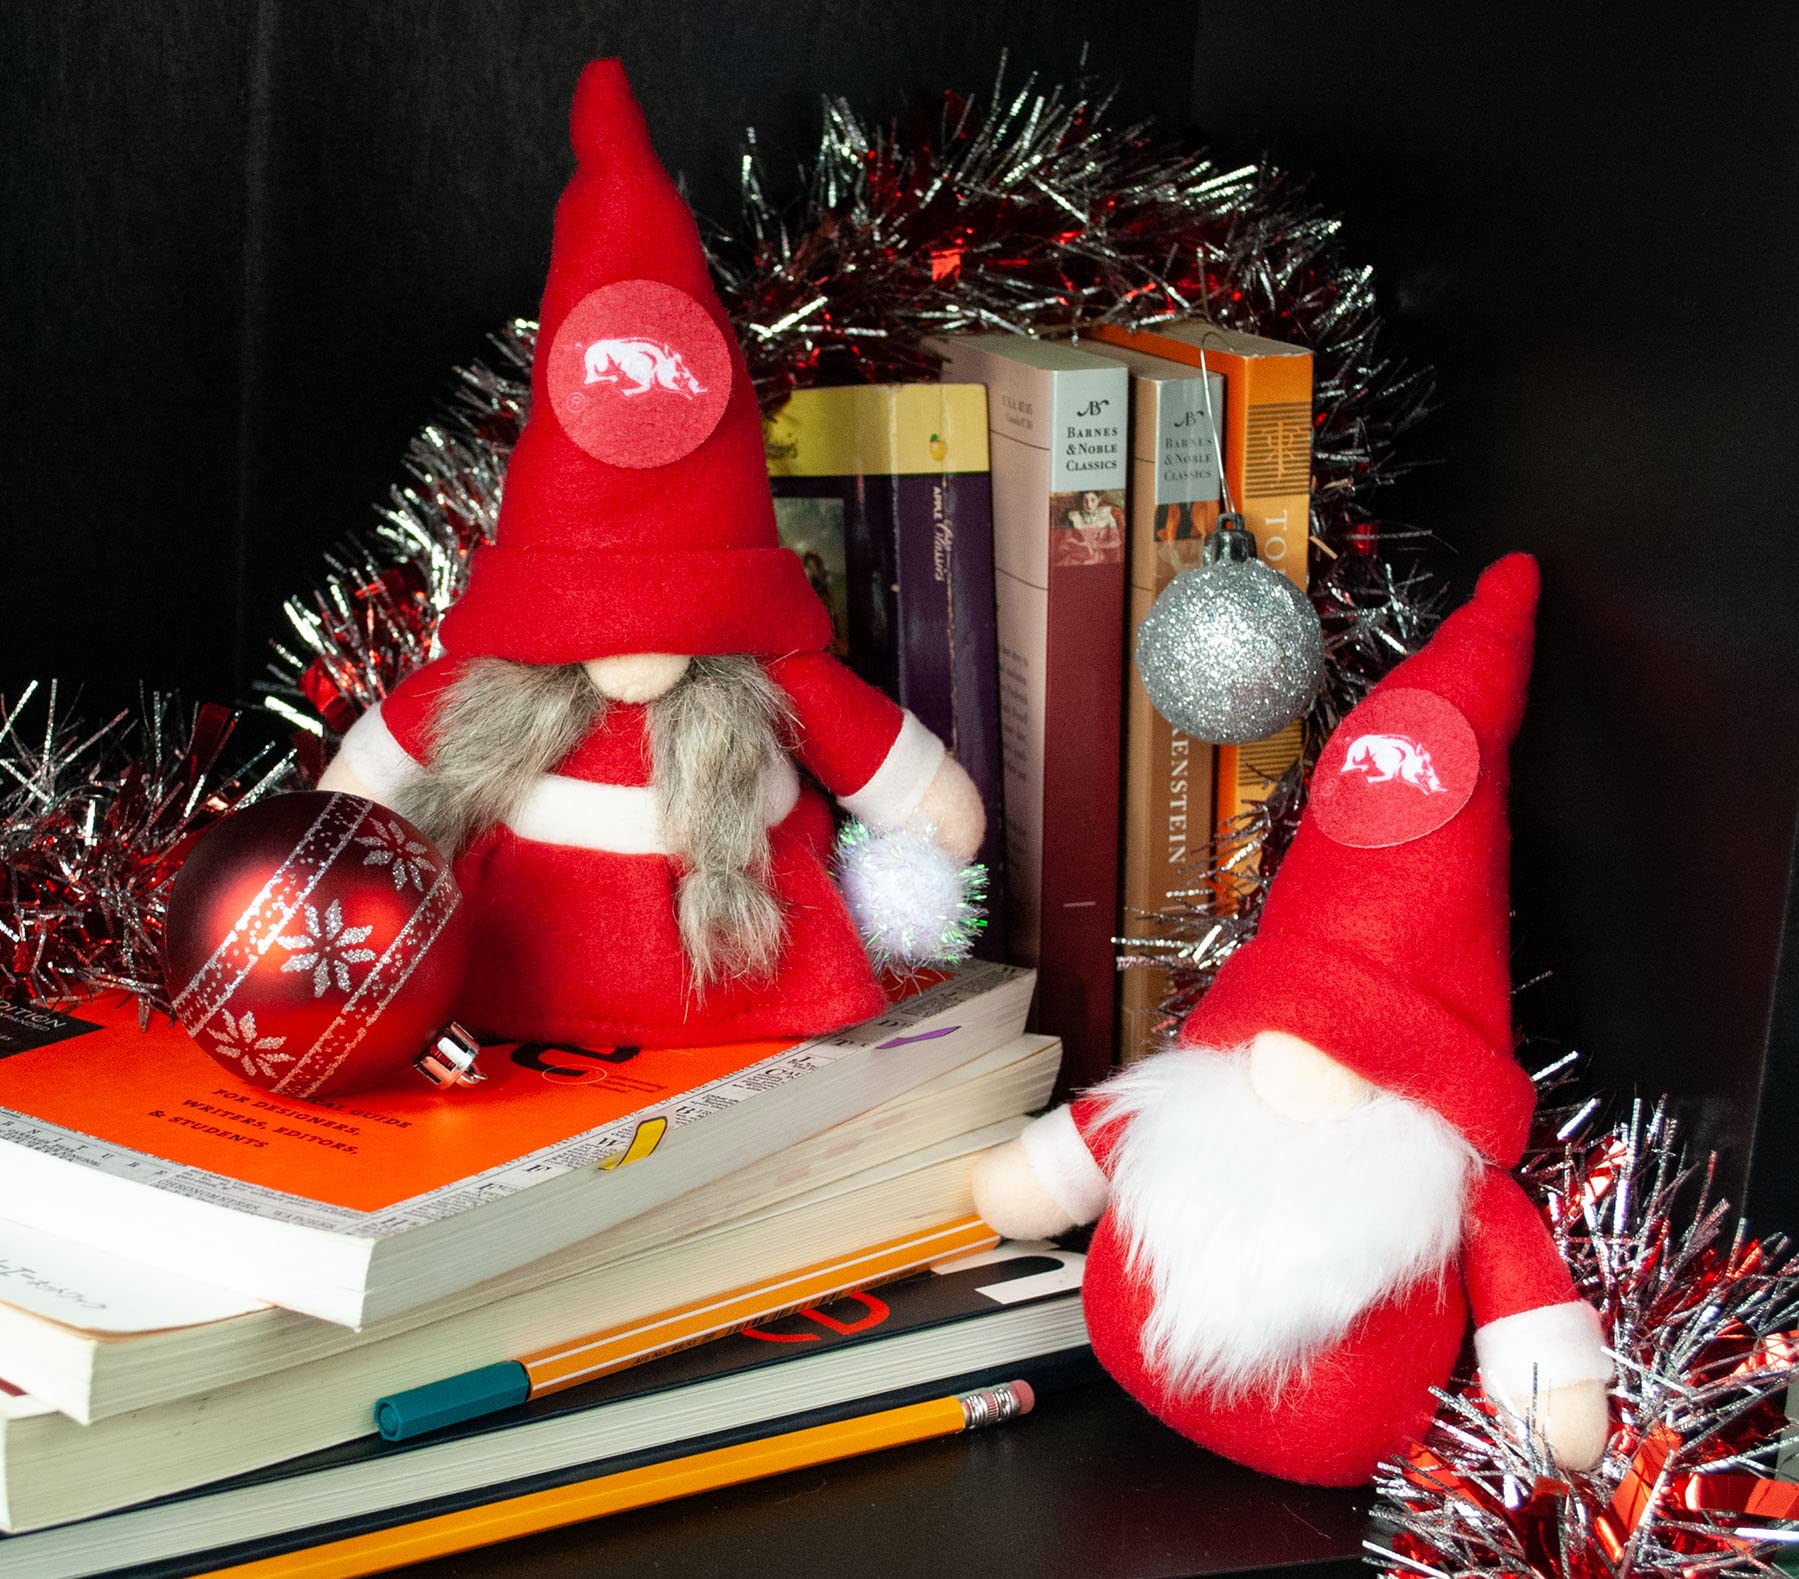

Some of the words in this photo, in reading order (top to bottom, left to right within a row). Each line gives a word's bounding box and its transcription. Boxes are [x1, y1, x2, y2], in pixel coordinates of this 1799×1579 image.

[1067, 426, 1118, 438] BARNES
[1165, 437, 1213, 449] BARNES
[1066, 460, 1118, 471] CLASSICS
[1164, 470, 1212, 481] CLASSICS
[1264, 508, 1288, 575] TO
[1168, 727, 1189, 864] ENSTEIN
[211, 1088, 250, 1103] FOR
[250, 1101, 360, 1136] DESIGNERS,
[349, 1109, 412, 1129] GUIDE
[148, 1110, 166, 1118] &
[168, 1116, 269, 1148] STUDENTS
[183, 1099, 268, 1130] WRITERS,
[272, 1126, 358, 1155] EDITORS,
